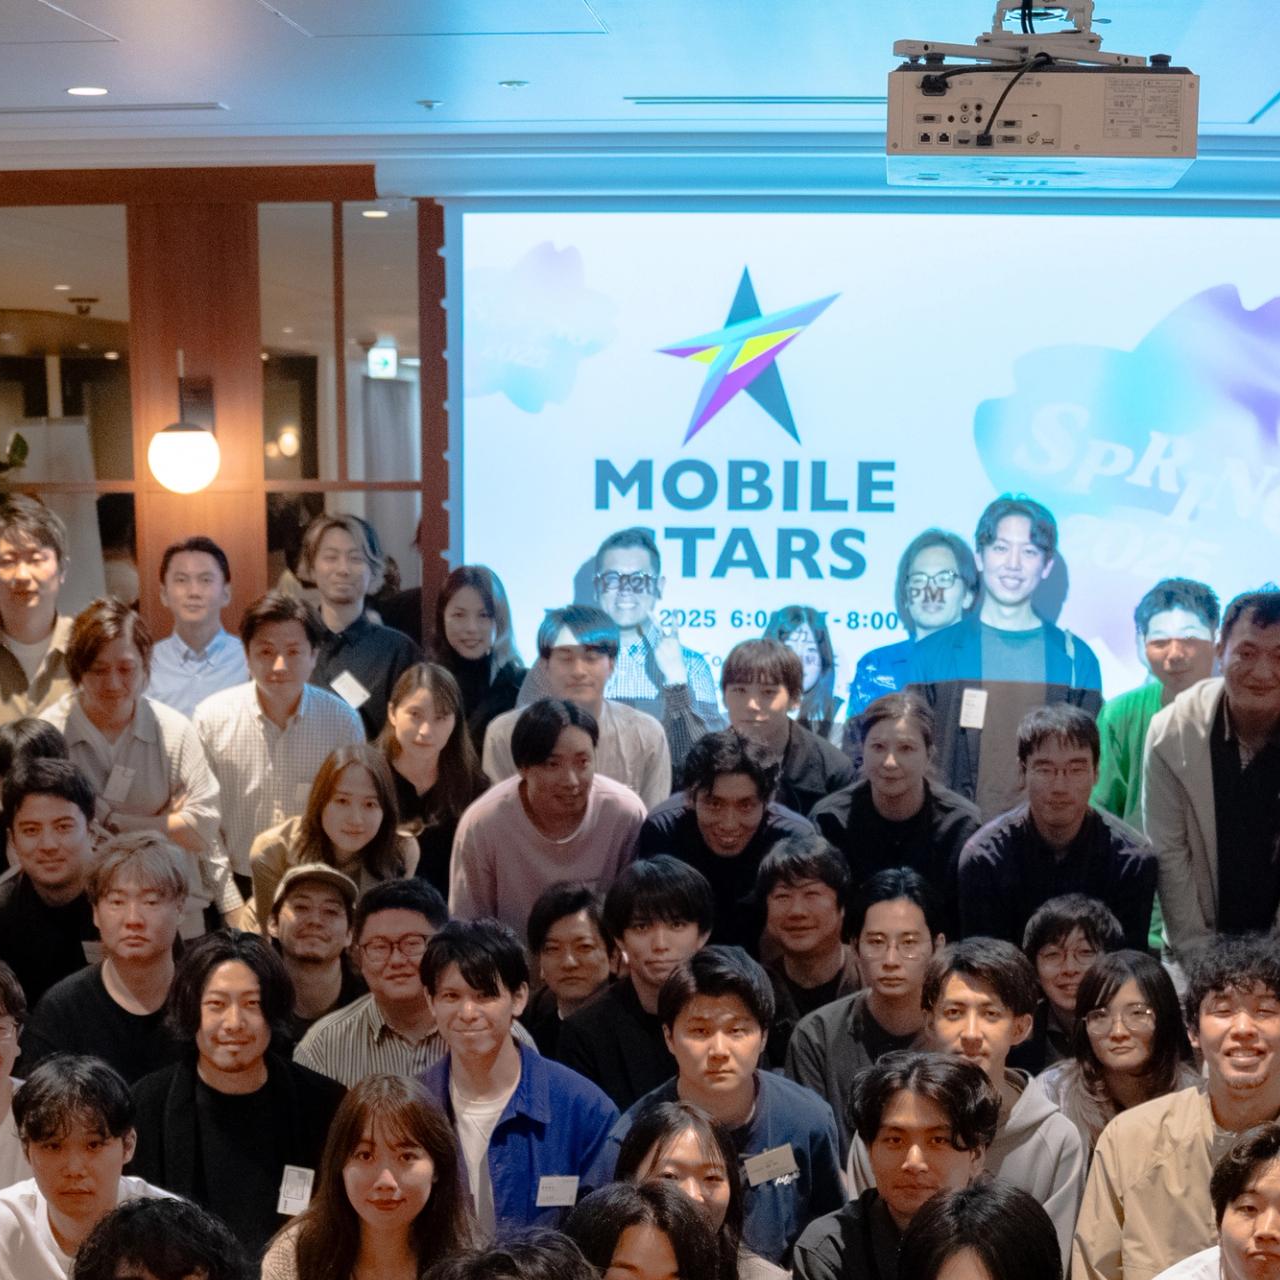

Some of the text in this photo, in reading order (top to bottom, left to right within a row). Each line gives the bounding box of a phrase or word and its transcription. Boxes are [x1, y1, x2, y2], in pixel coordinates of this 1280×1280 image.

[594, 458, 897, 513] MOBILE
[644, 526, 867, 580] TARS
[660, 608, 716, 628] 2025
